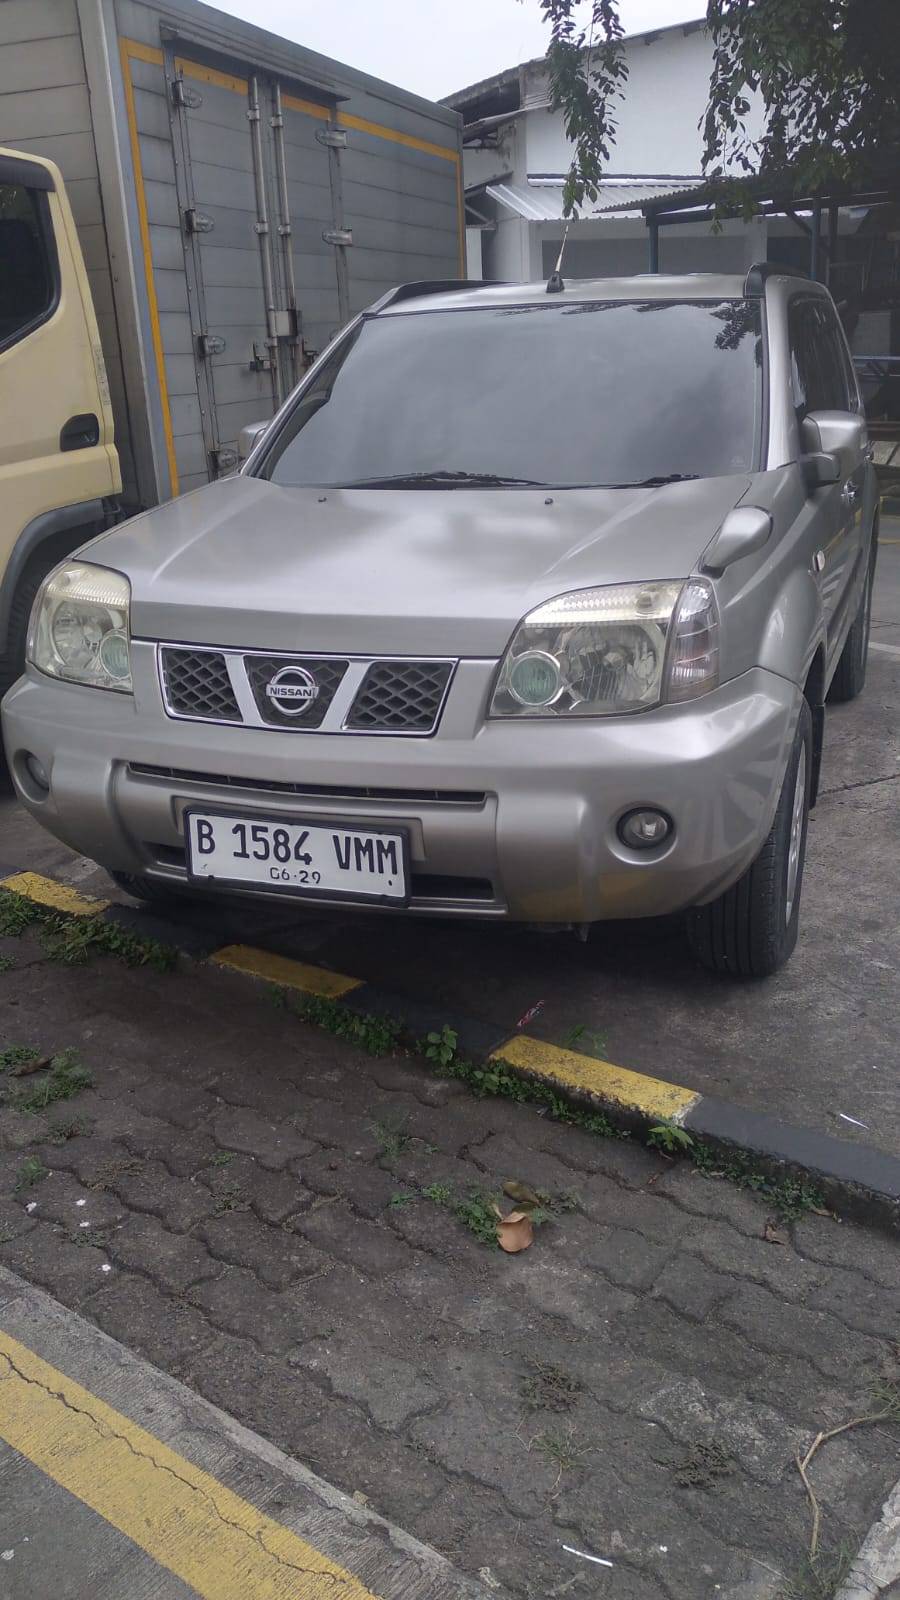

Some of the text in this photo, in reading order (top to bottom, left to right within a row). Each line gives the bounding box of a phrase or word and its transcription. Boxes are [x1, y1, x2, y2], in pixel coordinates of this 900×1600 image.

[270, 687, 312, 697] NISSAN
[197, 819, 398, 875] B 1584 VMM
